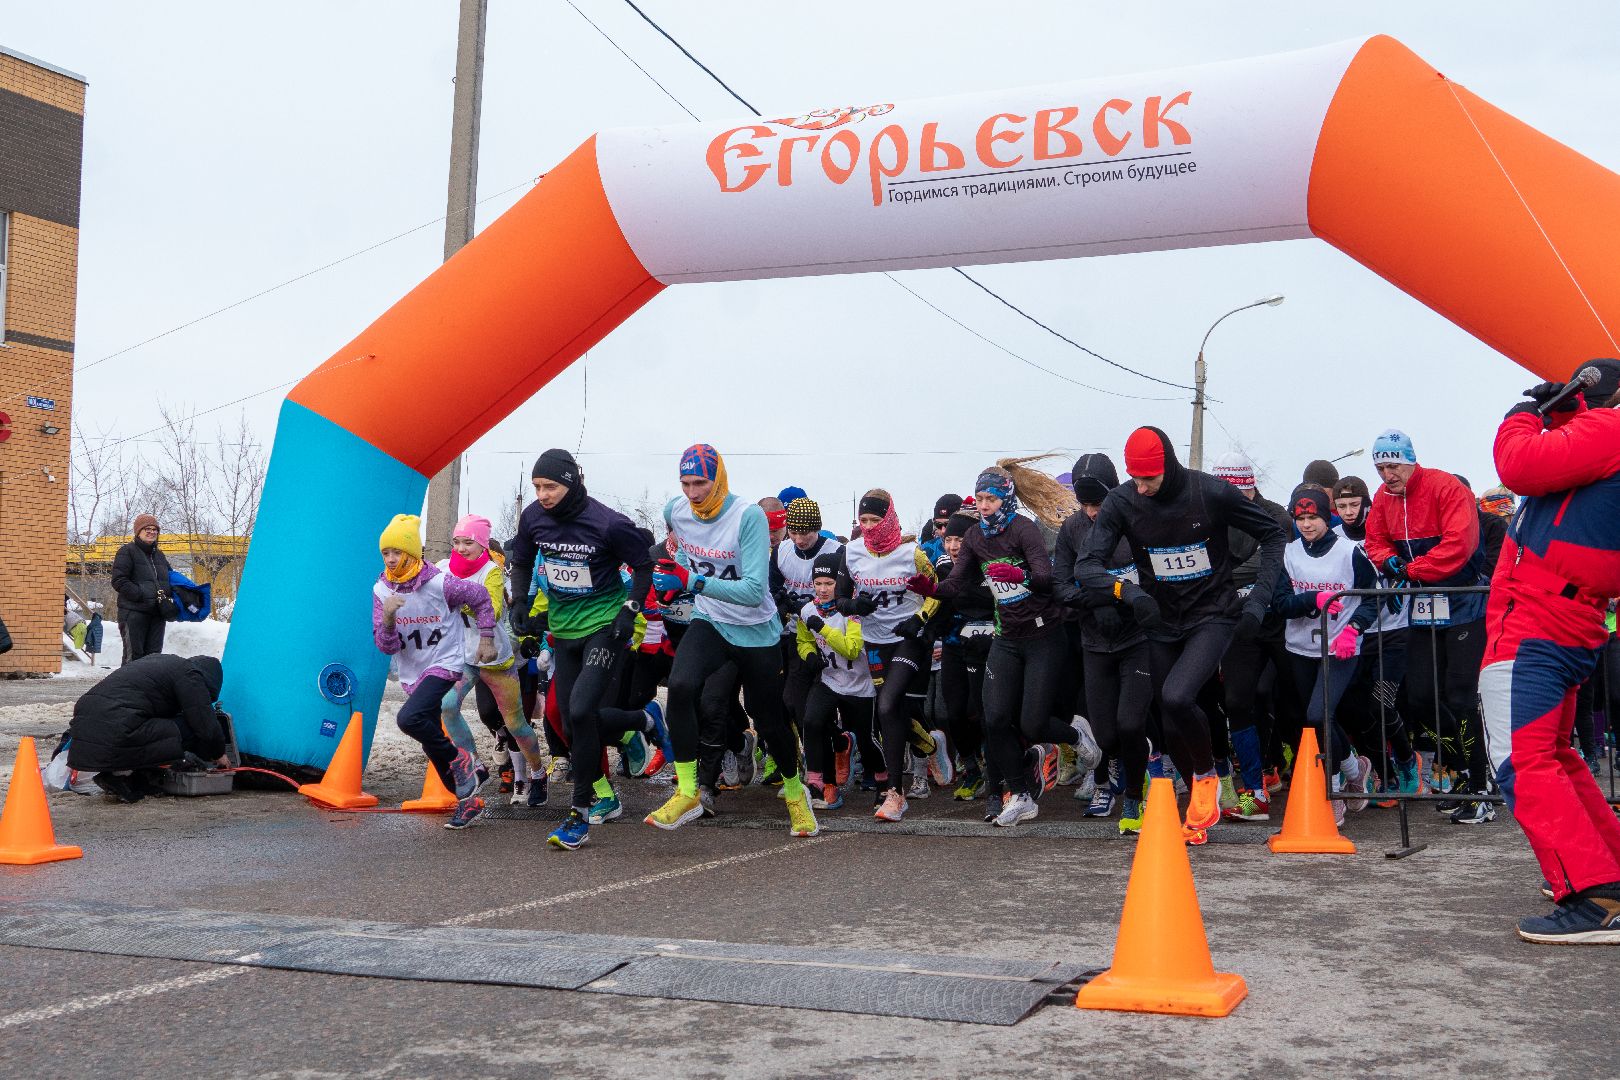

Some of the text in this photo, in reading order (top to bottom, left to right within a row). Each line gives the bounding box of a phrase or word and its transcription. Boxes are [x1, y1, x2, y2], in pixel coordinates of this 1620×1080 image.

[888, 161, 1197, 204] Гордимся традициями. Строим будущее
[1164, 555, 1196, 569] 115
[553, 568, 579, 582] 209
